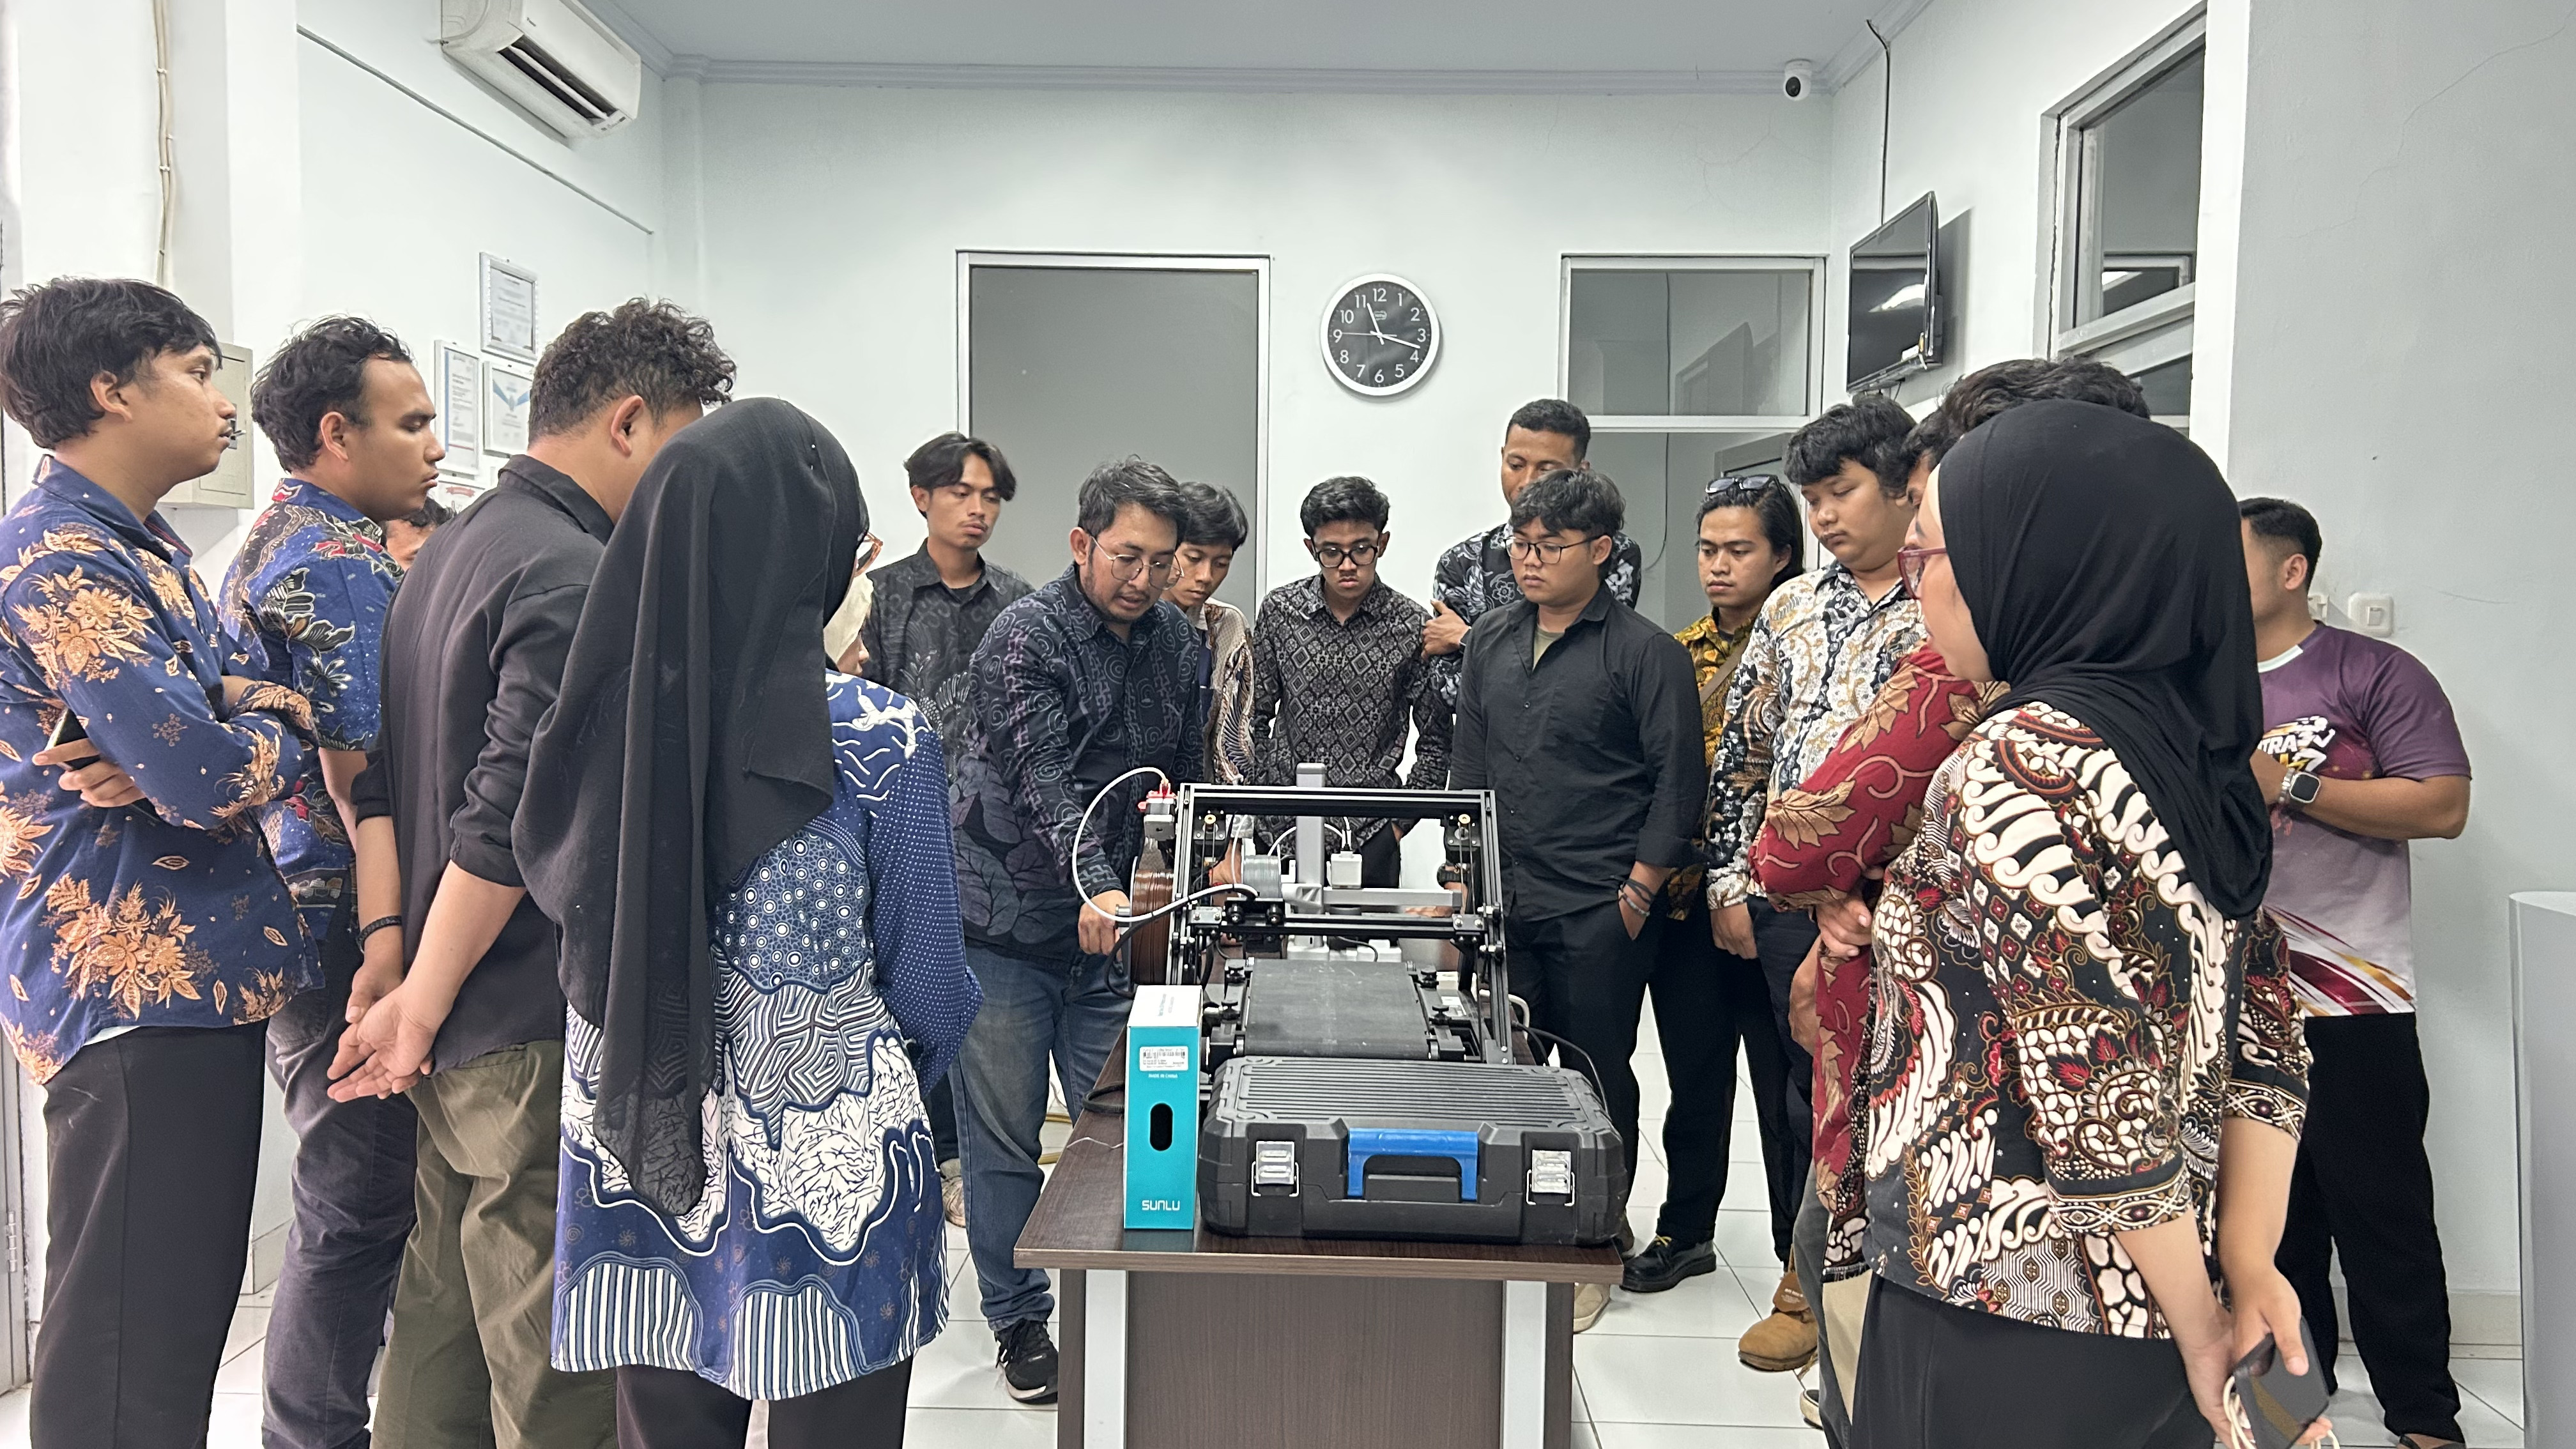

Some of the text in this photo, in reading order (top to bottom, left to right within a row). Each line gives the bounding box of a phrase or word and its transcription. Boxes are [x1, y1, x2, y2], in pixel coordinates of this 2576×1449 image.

[1355, 295, 1366, 308] 11
[1373, 288, 1387, 302] 12
[1397, 293, 1402, 306] 1
[1340, 309, 1354, 324] 10
[1411, 307, 1420, 321] 2
[1333, 329, 1342, 343] 9
[1417, 328, 1426, 342] 3
[1340, 349, 1349, 364] 8
[1409, 349, 1419, 362] 4
[1356, 364, 1365, 378] 7
[1374, 369, 1384, 383] 6
[1395, 364, 1404, 378] 5
[1142, 1200, 1180, 1211] SUNLU
